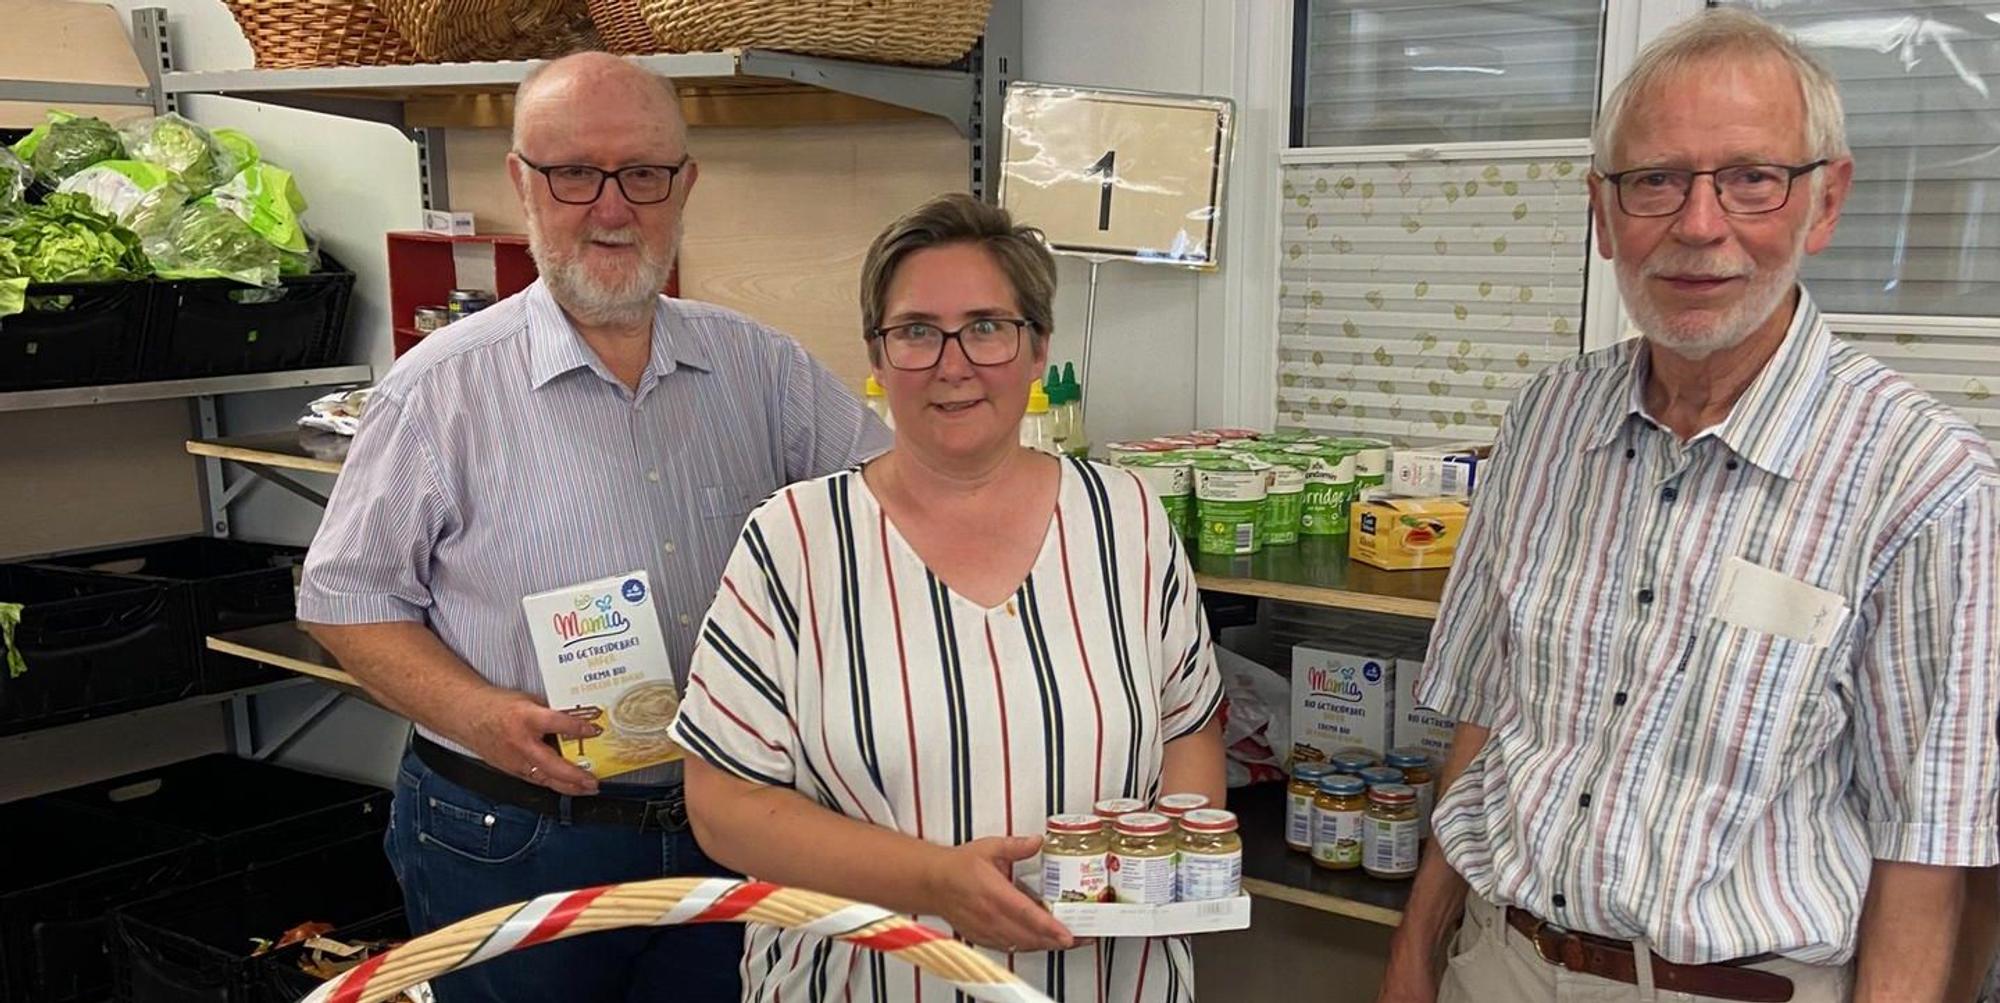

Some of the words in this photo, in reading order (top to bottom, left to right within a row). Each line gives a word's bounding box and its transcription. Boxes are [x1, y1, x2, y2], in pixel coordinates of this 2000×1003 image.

[1083, 151, 1116, 231] 1
[553, 610, 631, 641] Mamia
[558, 651, 574, 664] BIO
[576, 636, 640, 660] GETREIDEBREI
[584, 669, 611, 683] CREMA
[612, 665, 626, 676] BIO
[1308, 666, 1363, 696] Mamia
